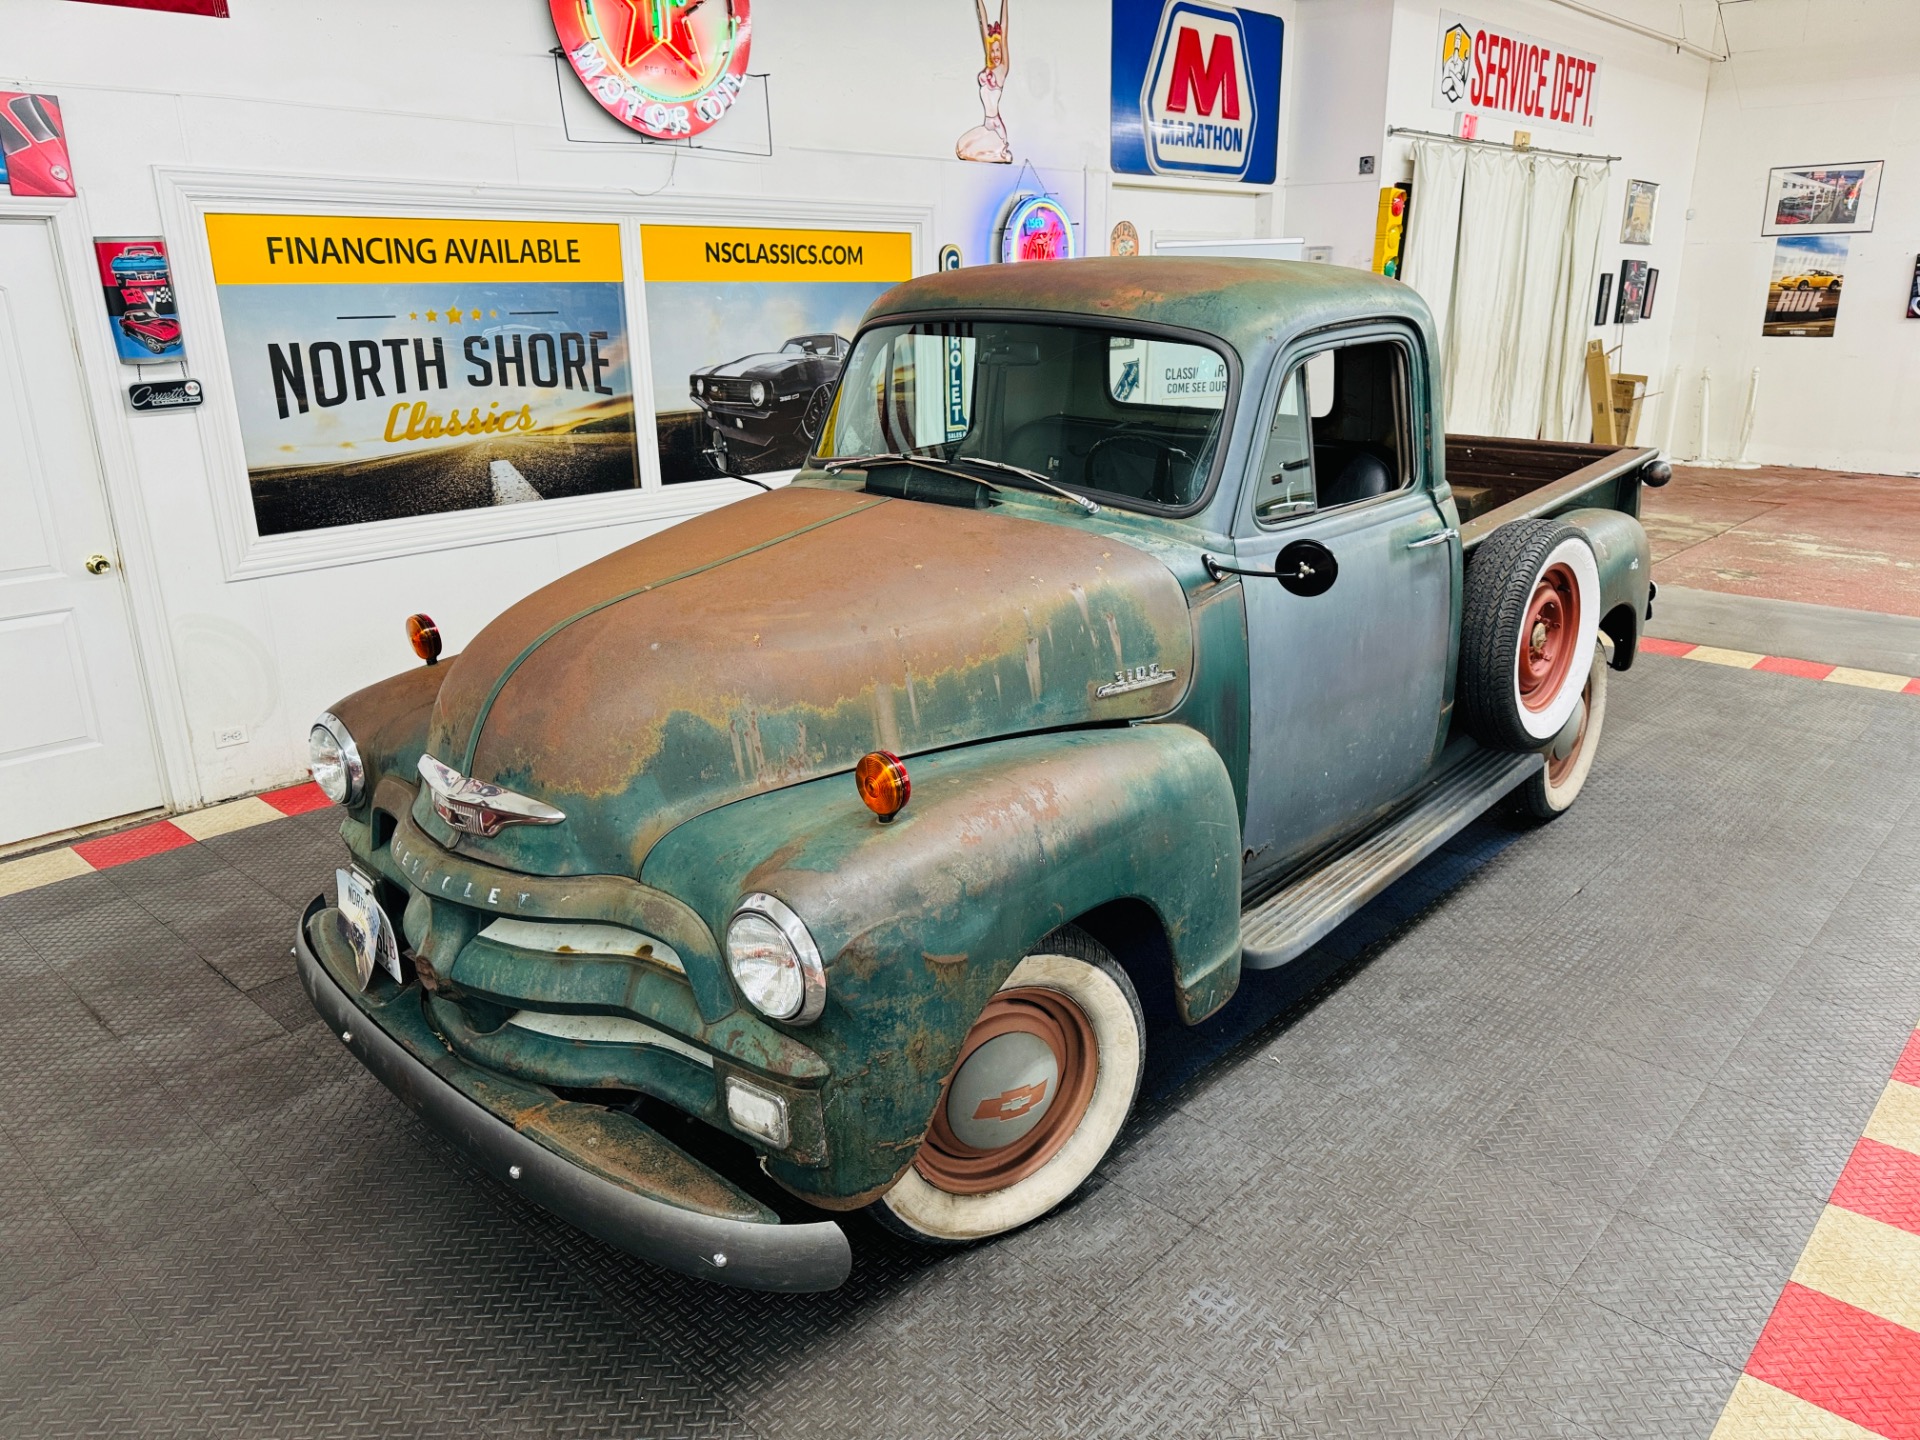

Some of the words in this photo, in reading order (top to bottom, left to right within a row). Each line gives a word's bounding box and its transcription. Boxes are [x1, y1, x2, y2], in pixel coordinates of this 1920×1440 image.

[570, 41, 691, 136] MOTOR
[694, 73, 748, 124] OIL
[1165, 26, 1240, 121] M
[1470, 29, 1550, 117] SERVICE
[1550, 53, 1597, 127] DEPT.
[1160, 118, 1243, 153] MARATHON
[266, 236, 437, 265] FINANCING
[444, 238, 581, 264] AVAILABLE
[705, 242, 863, 266] NSCLASSICS.COM
[1775, 290, 1823, 312] RIDE
[267, 336, 445, 419] NORTH
[465, 330, 613, 396] SHORE
[1167, 383, 1190, 394] COME
[1192, 382, 1206, 393] SEE
[1209, 381, 1227, 392] OUR
[131, 386, 187, 406] Corvette
[384, 400, 537, 443] Classics
